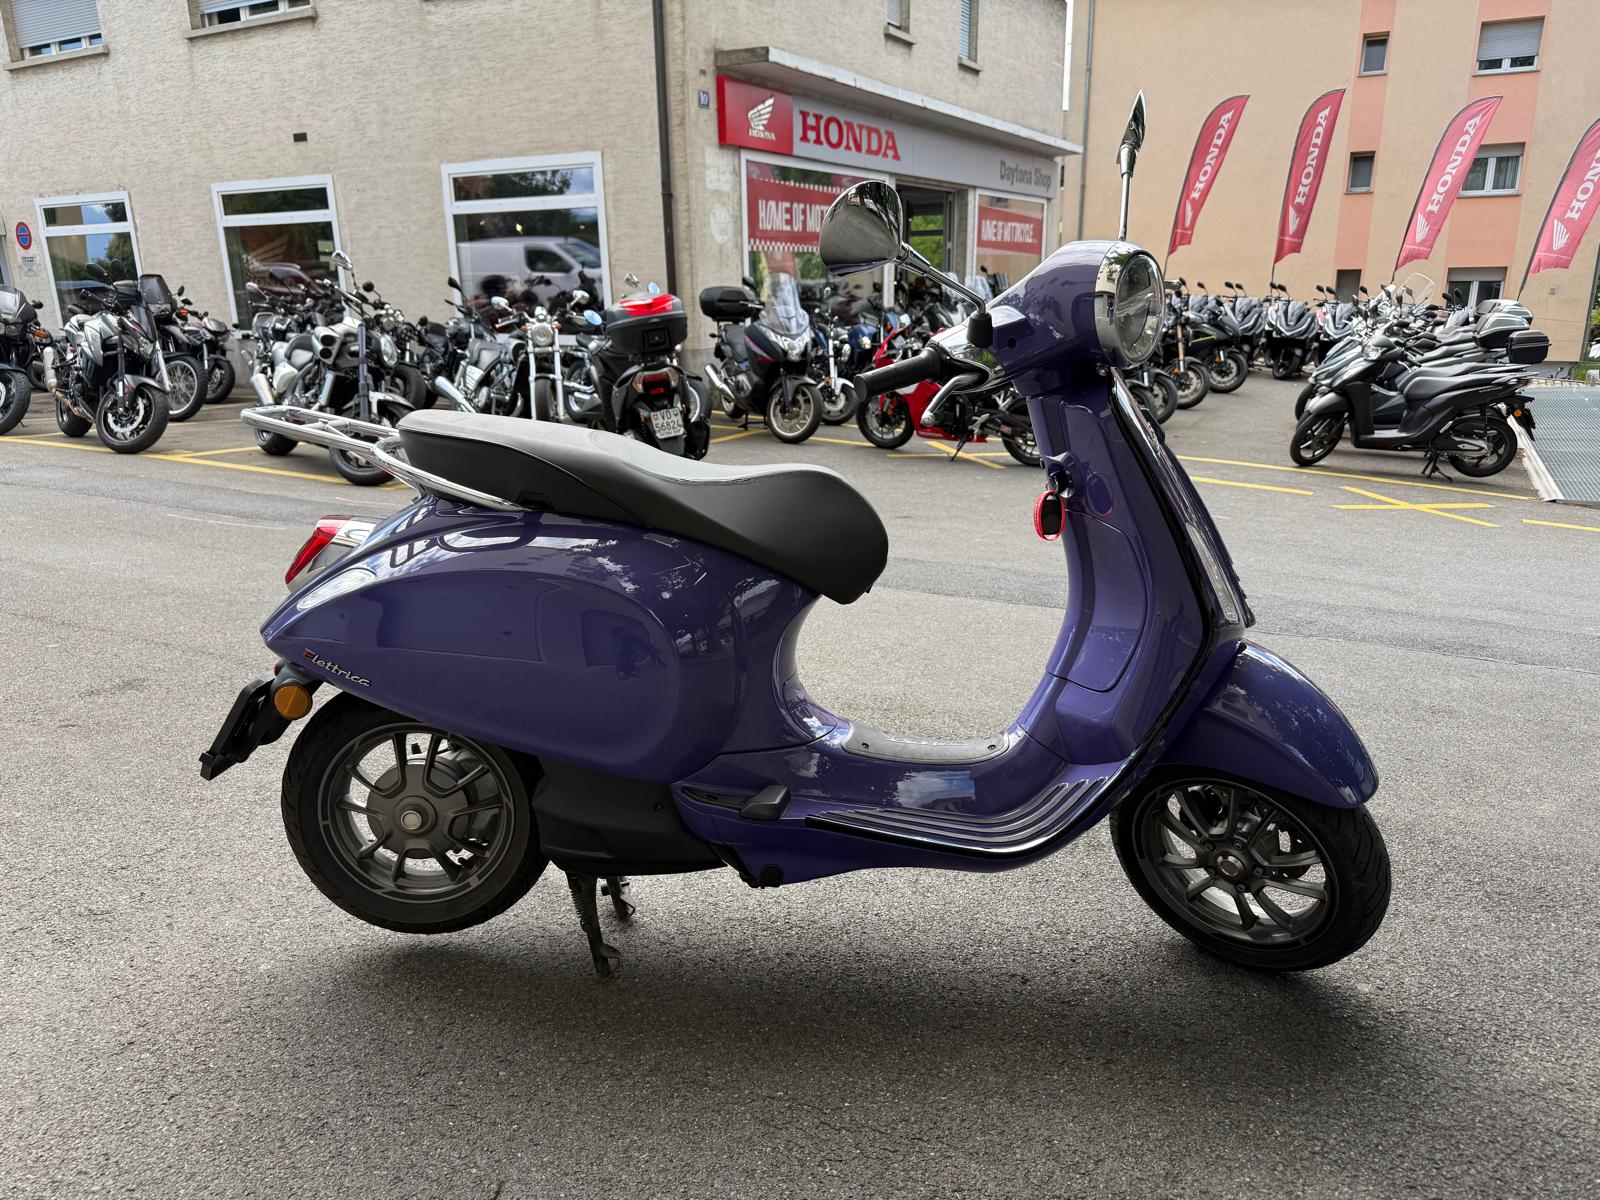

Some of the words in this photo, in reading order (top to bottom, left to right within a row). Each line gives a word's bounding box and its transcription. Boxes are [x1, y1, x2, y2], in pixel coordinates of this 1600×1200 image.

[748, 128, 776, 141] HONDA
[799, 110, 901, 161] HONDA
[1190, 110, 1234, 201] HONDA
[1294, 105, 1331, 205] HONDA
[1426, 114, 1483, 214] HONDA
[1000, 160, 1032, 186] Daytona
[1033, 167, 1052, 192] Shop
[758, 199, 791, 231] HOME
[792, 202, 805, 232] OF
[806, 204, 833, 233] MOT
[655, 419, 682, 432] 56824
[660, 410, 672, 420] VD
[303, 648, 370, 687] Elettrica
